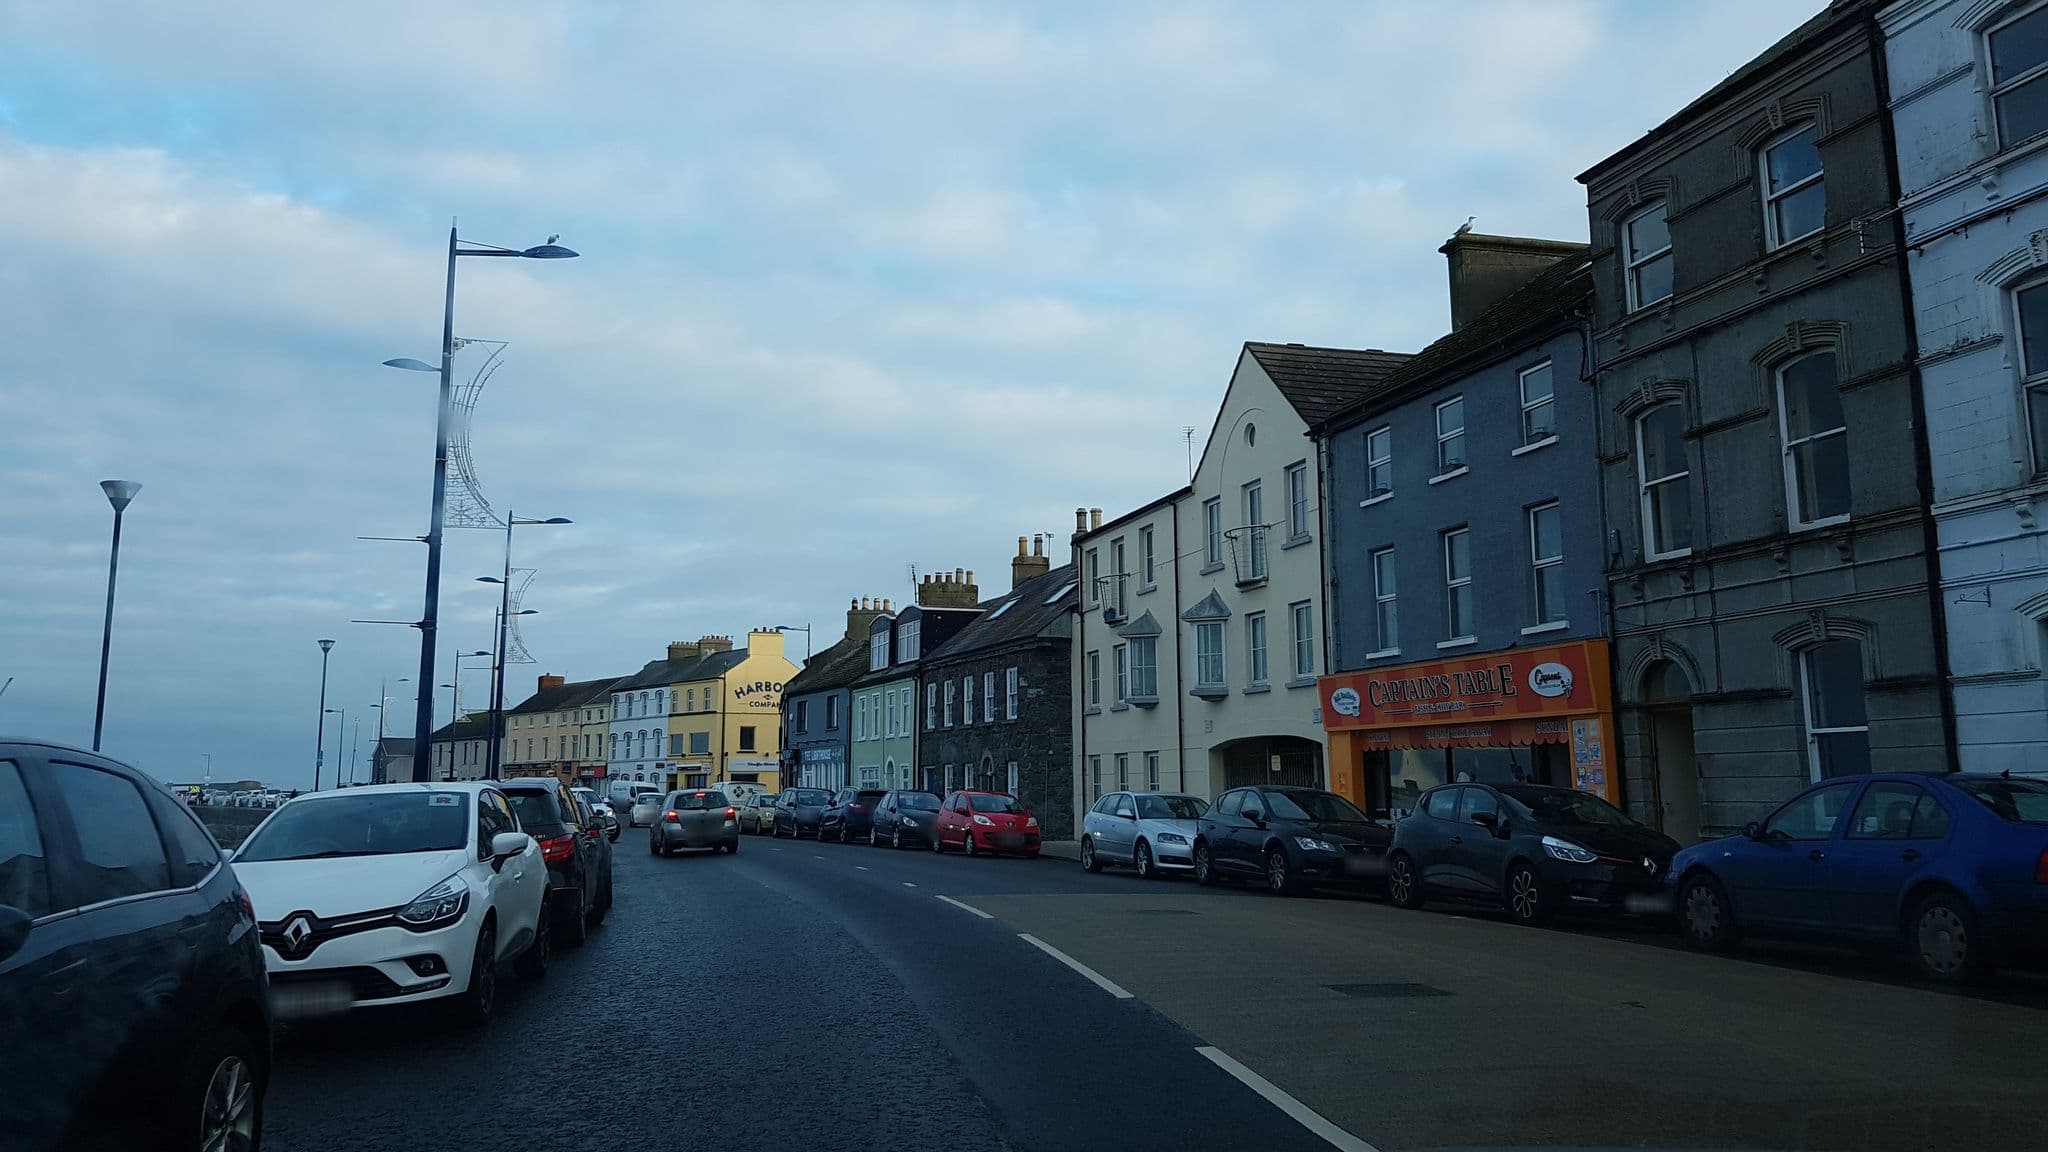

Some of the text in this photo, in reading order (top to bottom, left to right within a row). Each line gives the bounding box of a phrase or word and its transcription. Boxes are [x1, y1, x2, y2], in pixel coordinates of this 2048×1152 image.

[734, 681, 783, 699] HARBO
[1369, 663, 1518, 708] CAPTAIN'S TABLE
